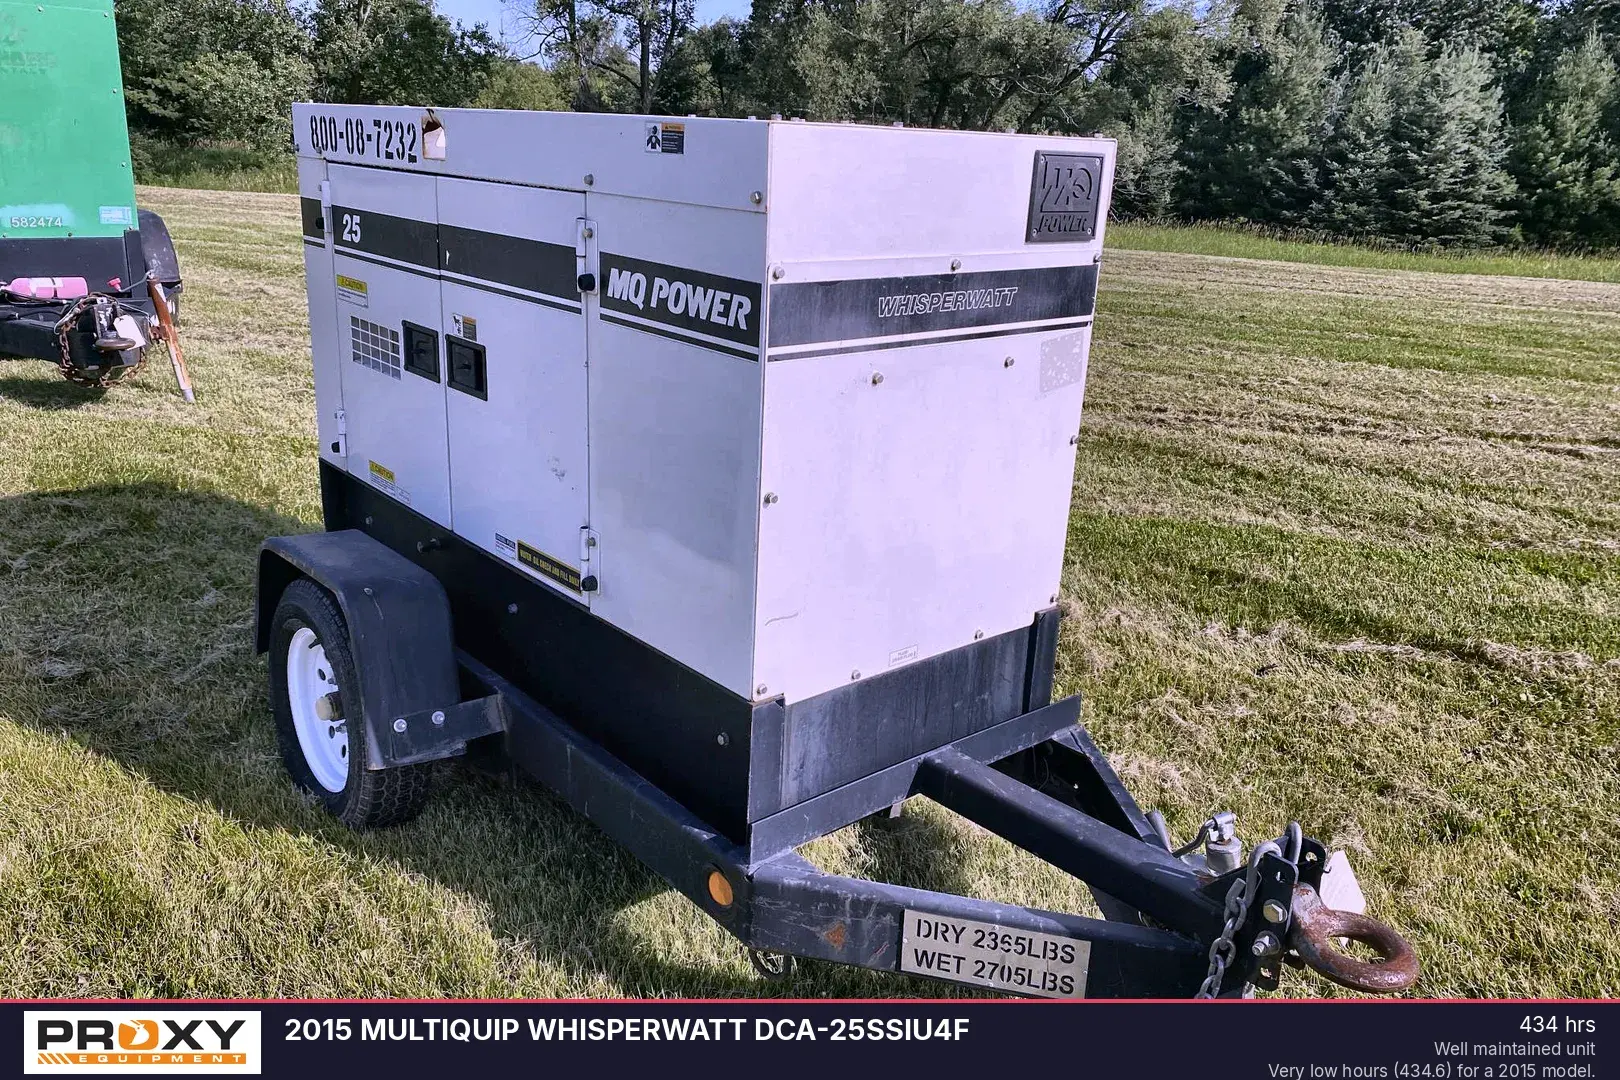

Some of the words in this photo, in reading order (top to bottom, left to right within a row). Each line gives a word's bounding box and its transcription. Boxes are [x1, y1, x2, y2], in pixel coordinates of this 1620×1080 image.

[310, 115, 418, 163] 800-08-7232
[11, 216, 63, 228] 582474
[342, 213, 362, 243] 25
[1038, 214, 1087, 233] POWER
[607, 267, 647, 310] MQ
[650, 277, 752, 330] POWER
[878, 287, 1018, 317] WHISPERWATT
[916, 918, 966, 944] DRY
[973, 929, 1075, 964] 2365LBS
[914, 948, 966, 974] WET
[972, 960, 1075, 995] 2705LBS
